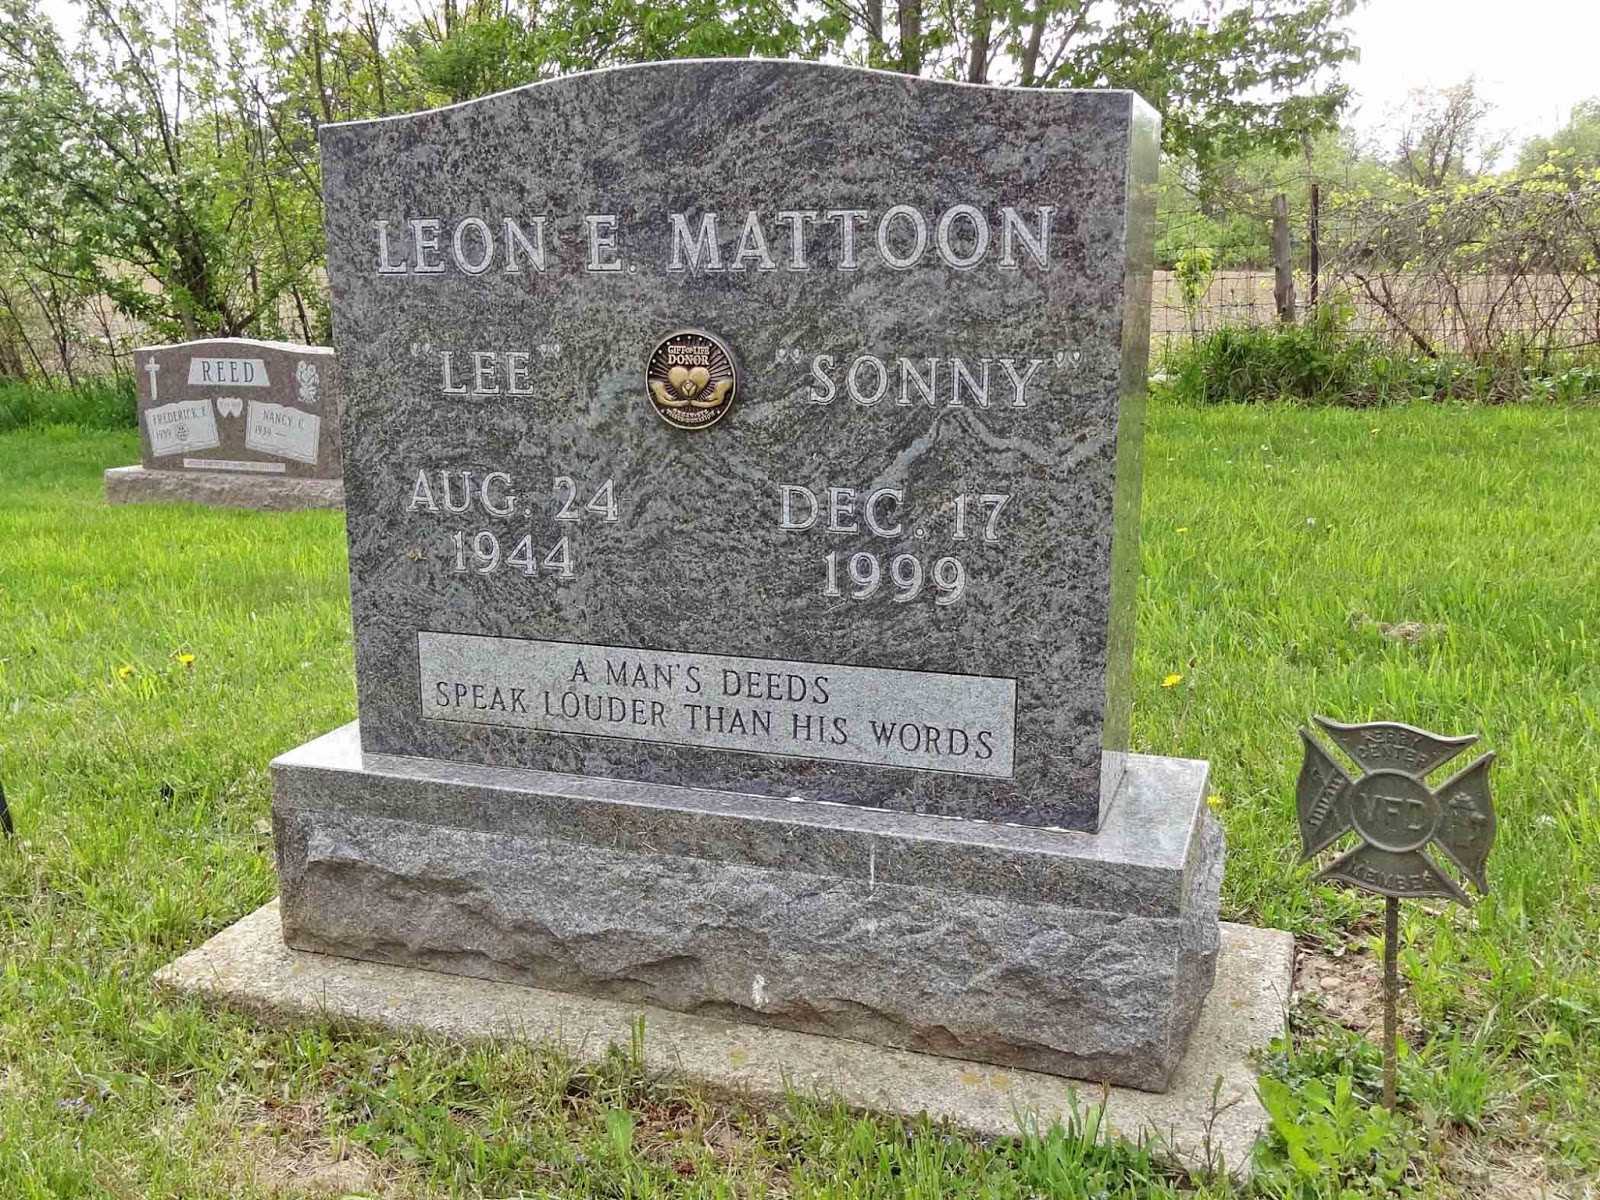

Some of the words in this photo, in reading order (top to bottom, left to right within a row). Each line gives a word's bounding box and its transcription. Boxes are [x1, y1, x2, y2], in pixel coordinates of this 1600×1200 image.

[374, 214, 550, 277] LEON
[585, 213, 639, 275] E.
[667, 203, 1058, 277] MATTOON
[201, 360, 255, 384] REED
[410, 342, 561, 396] "LEE"
[668, 355, 710, 365] DONOR
[775, 346, 1083, 408] "SONNY"
[263, 409, 293, 428] NANCY
[406, 468, 532, 518] AUG.
[553, 475, 621, 524] 24
[778, 484, 926, 539] DEC.
[951, 492, 1015, 543] 17
[452, 529, 575, 579] 1944
[824, 550, 967, 606] 1999
[570, 656, 590, 683] A
[605, 658, 701, 694] MAN'S
[721, 668, 830, 705] DEEDS
[435, 681, 528, 714] SPEAK
[543, 689, 667, 728] LOUDER
[683, 703, 772, 736] THAN
[791, 712, 848, 745] HIS
[869, 720, 994, 760] WORDS
